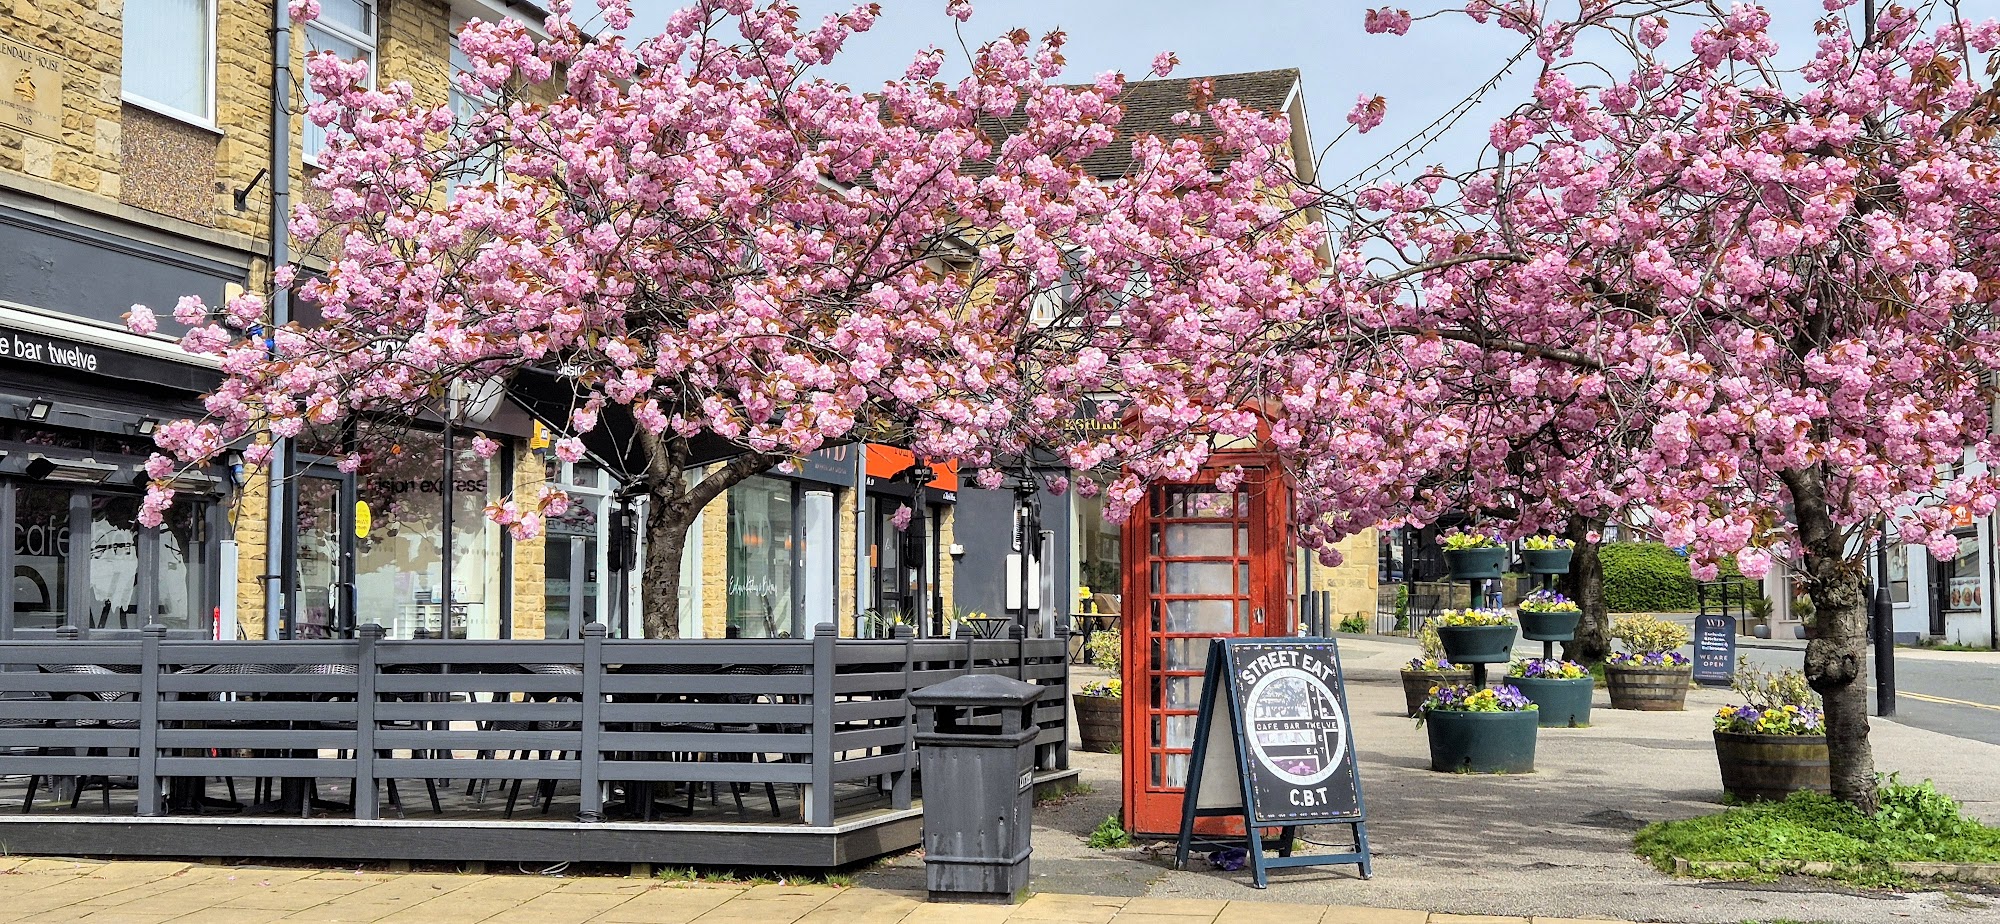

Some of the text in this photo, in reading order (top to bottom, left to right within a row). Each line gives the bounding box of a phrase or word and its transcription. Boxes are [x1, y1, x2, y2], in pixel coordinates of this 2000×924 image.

[14, 334, 42, 361] bar
[47, 341, 97, 371] twelve
[1242, 650, 1334, 685] STREET EAT
[1256, 723, 1279, 731] CAFE
[1306, 747, 1325, 755] EAT
[1289, 787, 1328, 807] C.B.T
